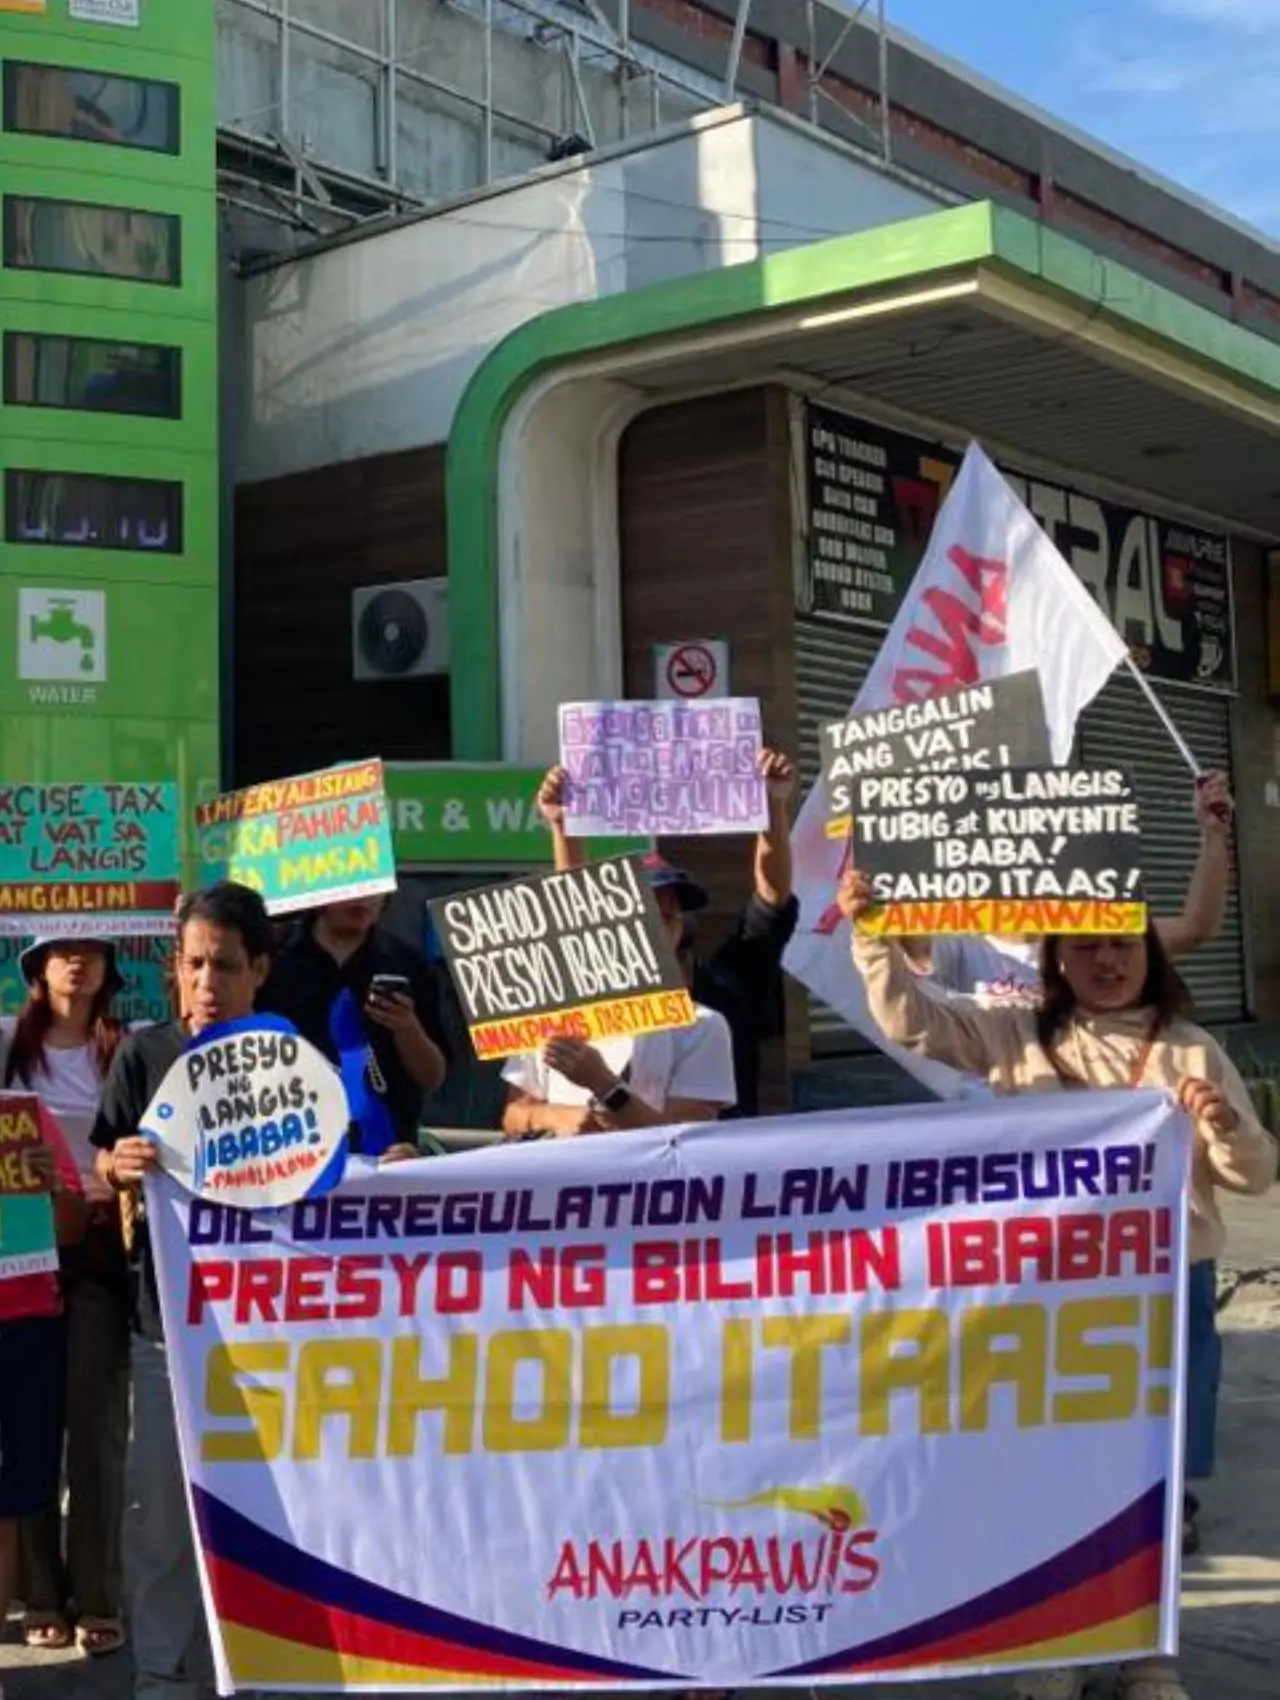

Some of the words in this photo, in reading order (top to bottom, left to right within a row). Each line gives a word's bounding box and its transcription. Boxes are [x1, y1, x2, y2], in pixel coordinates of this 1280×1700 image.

[826, 685, 994, 748] TANGGALIN
[829, 742, 895, 781] ANG
[904, 719, 977, 759] VAT
[102, 785, 166, 813] TAX
[860, 773, 968, 808] PRESYO
[1002, 770, 1131, 801] LANGIS,
[45, 819, 102, 845] VAT
[113, 821, 147, 843] SA
[856, 810, 949, 842] TUBIG
[30, 844, 149, 872] LANGIS
[934, 836, 1067, 868] IBABA!
[444, 883, 549, 954] SAHOD
[541, 858, 647, 931] ITAAS!
[872, 871, 991, 899] SAHOD
[1000, 868, 1141, 899] ITAAS!
[454, 945, 566, 1018] PRESYO
[559, 920, 663, 998] IBABA!
[594, 994, 694, 1037] PARTYLIST
[186, 1035, 299, 1092] PRESYO
[227, 1075, 252, 1097] NG
[206, 1108, 321, 1168] IBABA!
[188, 1200, 273, 1245] OIL
[292, 1173, 725, 1242] DEREGULATION
[740, 1163, 869, 1219] LAW
[885, 1142, 1157, 1210] IBASURA!
[187, 1249, 483, 1328] PRESYO
[507, 1242, 607, 1310] NG
[632, 1226, 903, 1306] BILIHIN
[926, 1206, 1173, 1292] IBABA!
[200, 1322, 672, 1465] SAHOD
[720, 1293, 1173, 1444] ITAAS!
[547, 1527, 881, 1601] ANAKPAWIS
[618, 1603, 834, 1629] PARTY-LIST
